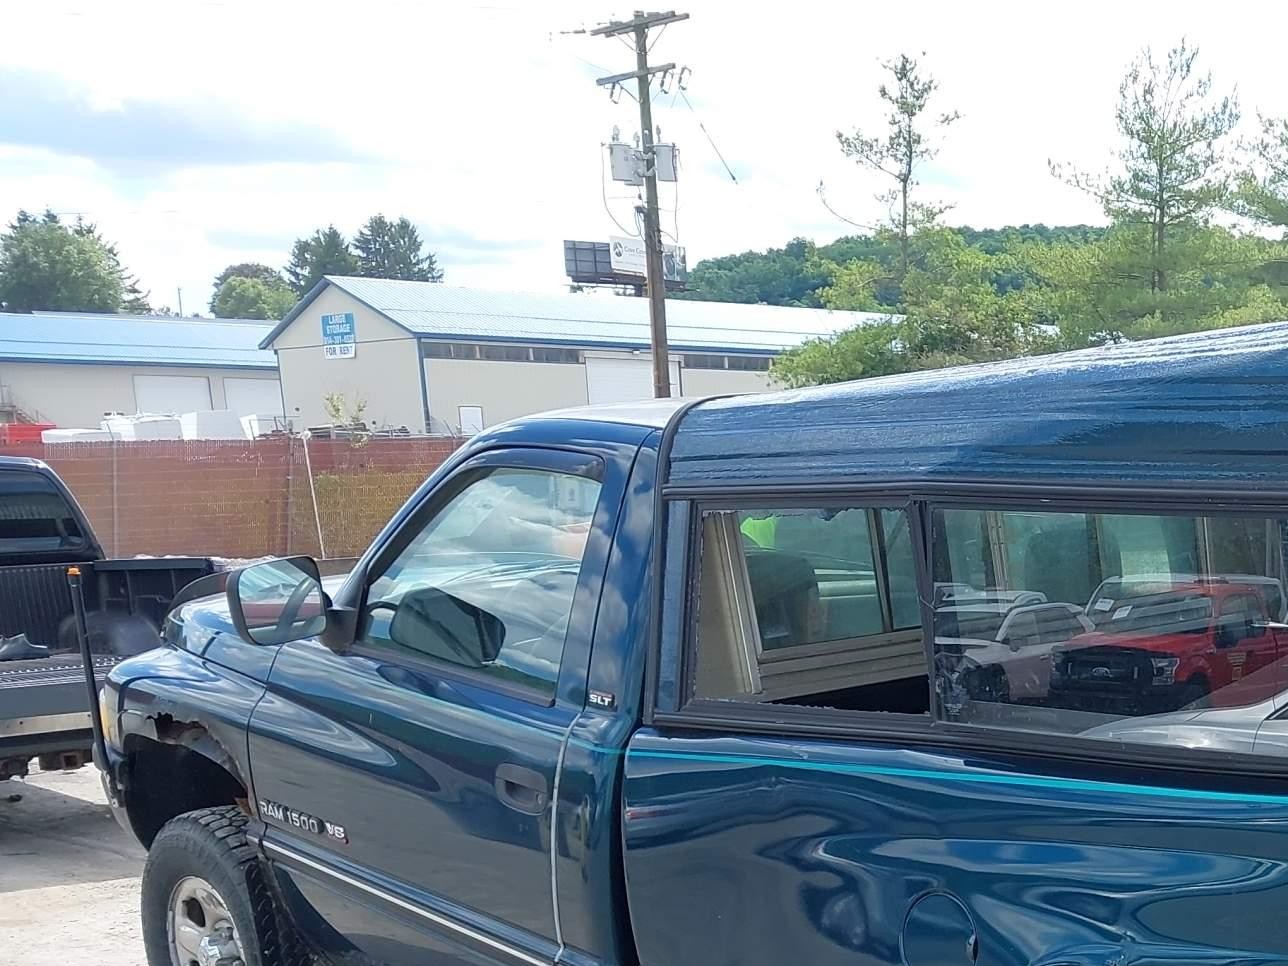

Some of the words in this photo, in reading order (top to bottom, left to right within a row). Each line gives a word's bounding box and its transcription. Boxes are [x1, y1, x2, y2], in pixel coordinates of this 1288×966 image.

[326, 324, 351, 335] STORAGE
[325, 347, 337, 356] FOR
[339, 346, 353, 355] RENT
[589, 694, 612, 706] SLT
[259, 800, 285, 822] RAM
[287, 809, 318, 833] 1500
